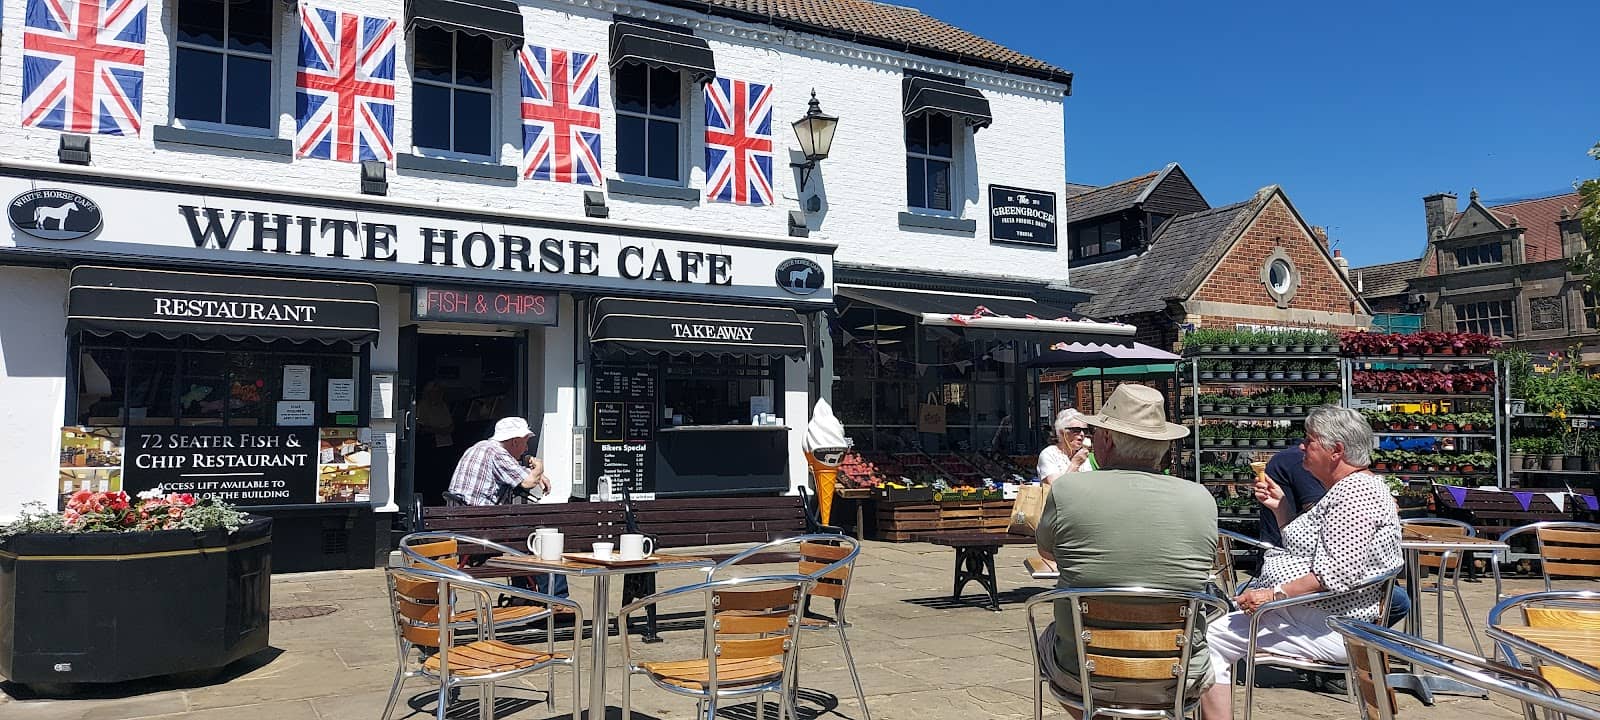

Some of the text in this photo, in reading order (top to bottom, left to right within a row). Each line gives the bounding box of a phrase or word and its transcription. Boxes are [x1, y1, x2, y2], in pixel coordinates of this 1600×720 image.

[14, 192, 42, 208] WHITE
[43, 190, 73, 200] HORSE
[1016, 195, 1030, 205] The
[993, 206, 1055, 224] GREENGROCER
[178, 204, 733, 286] WHITE HORSE CAFE
[154, 298, 317, 322] RESTAURANT
[427, 291, 545, 315] FISH & CHIPS
[671, 323, 755, 342] TAKEAWAY
[140, 433, 301, 449] 72 SEATER FISH &
[601, 444, 647, 453] Bikers Special
[135, 453, 308, 469] CHIP RESTAURANT
[157, 480, 286, 491] ACCESS LIFT AVAILABLE TO
[203, 492, 217, 500] OF
[219, 491, 239, 499] THE
[241, 489, 290, 499] BUILDING
